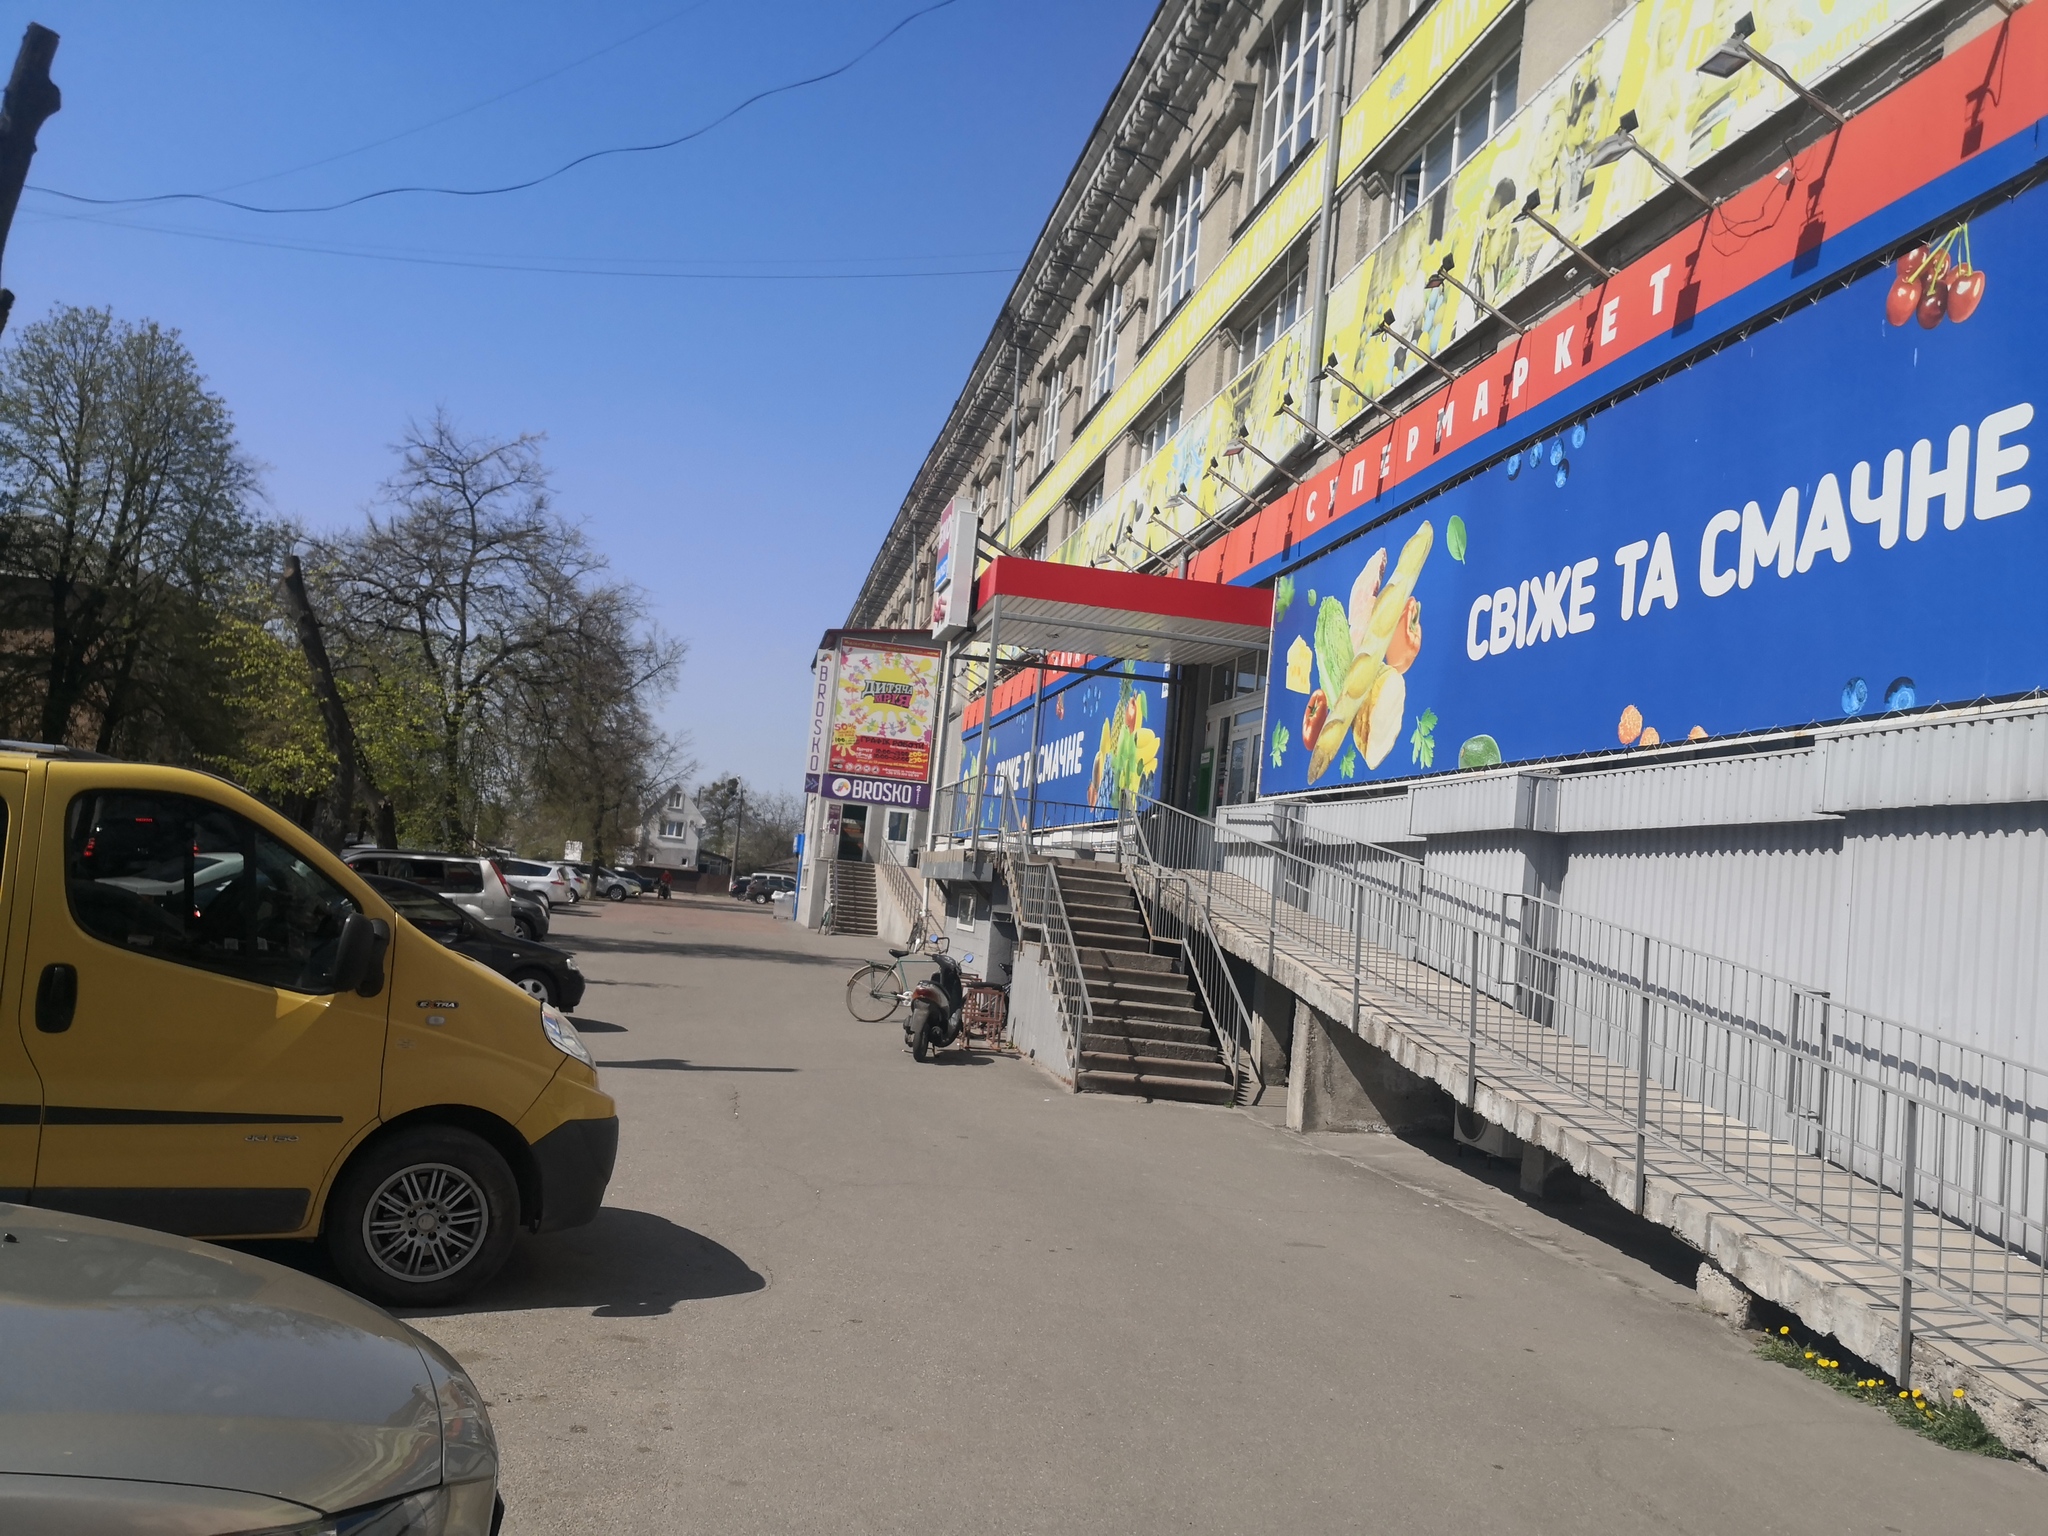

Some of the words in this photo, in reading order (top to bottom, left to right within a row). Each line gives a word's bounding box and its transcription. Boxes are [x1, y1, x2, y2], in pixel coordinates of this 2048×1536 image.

[1305, 264, 1672, 522] СУПЕРМАРКЕТ
[1467, 557, 1599, 661] СВІЖЕ
[1615, 532, 1678, 621] ТА
[1699, 402, 2035, 598] СМАЧНЕ
[861, 680, 913, 699] ДИТЯЧА
[810, 665, 828, 771] BROSKO
[834, 723, 857, 731] 50%
[860, 735, 890, 745] ГРАФІК
[891, 740, 925, 750] РОБОТИ
[1036, 731, 1084, 784] СМАЧНЕ
[852, 778, 912, 804] BROSKO
